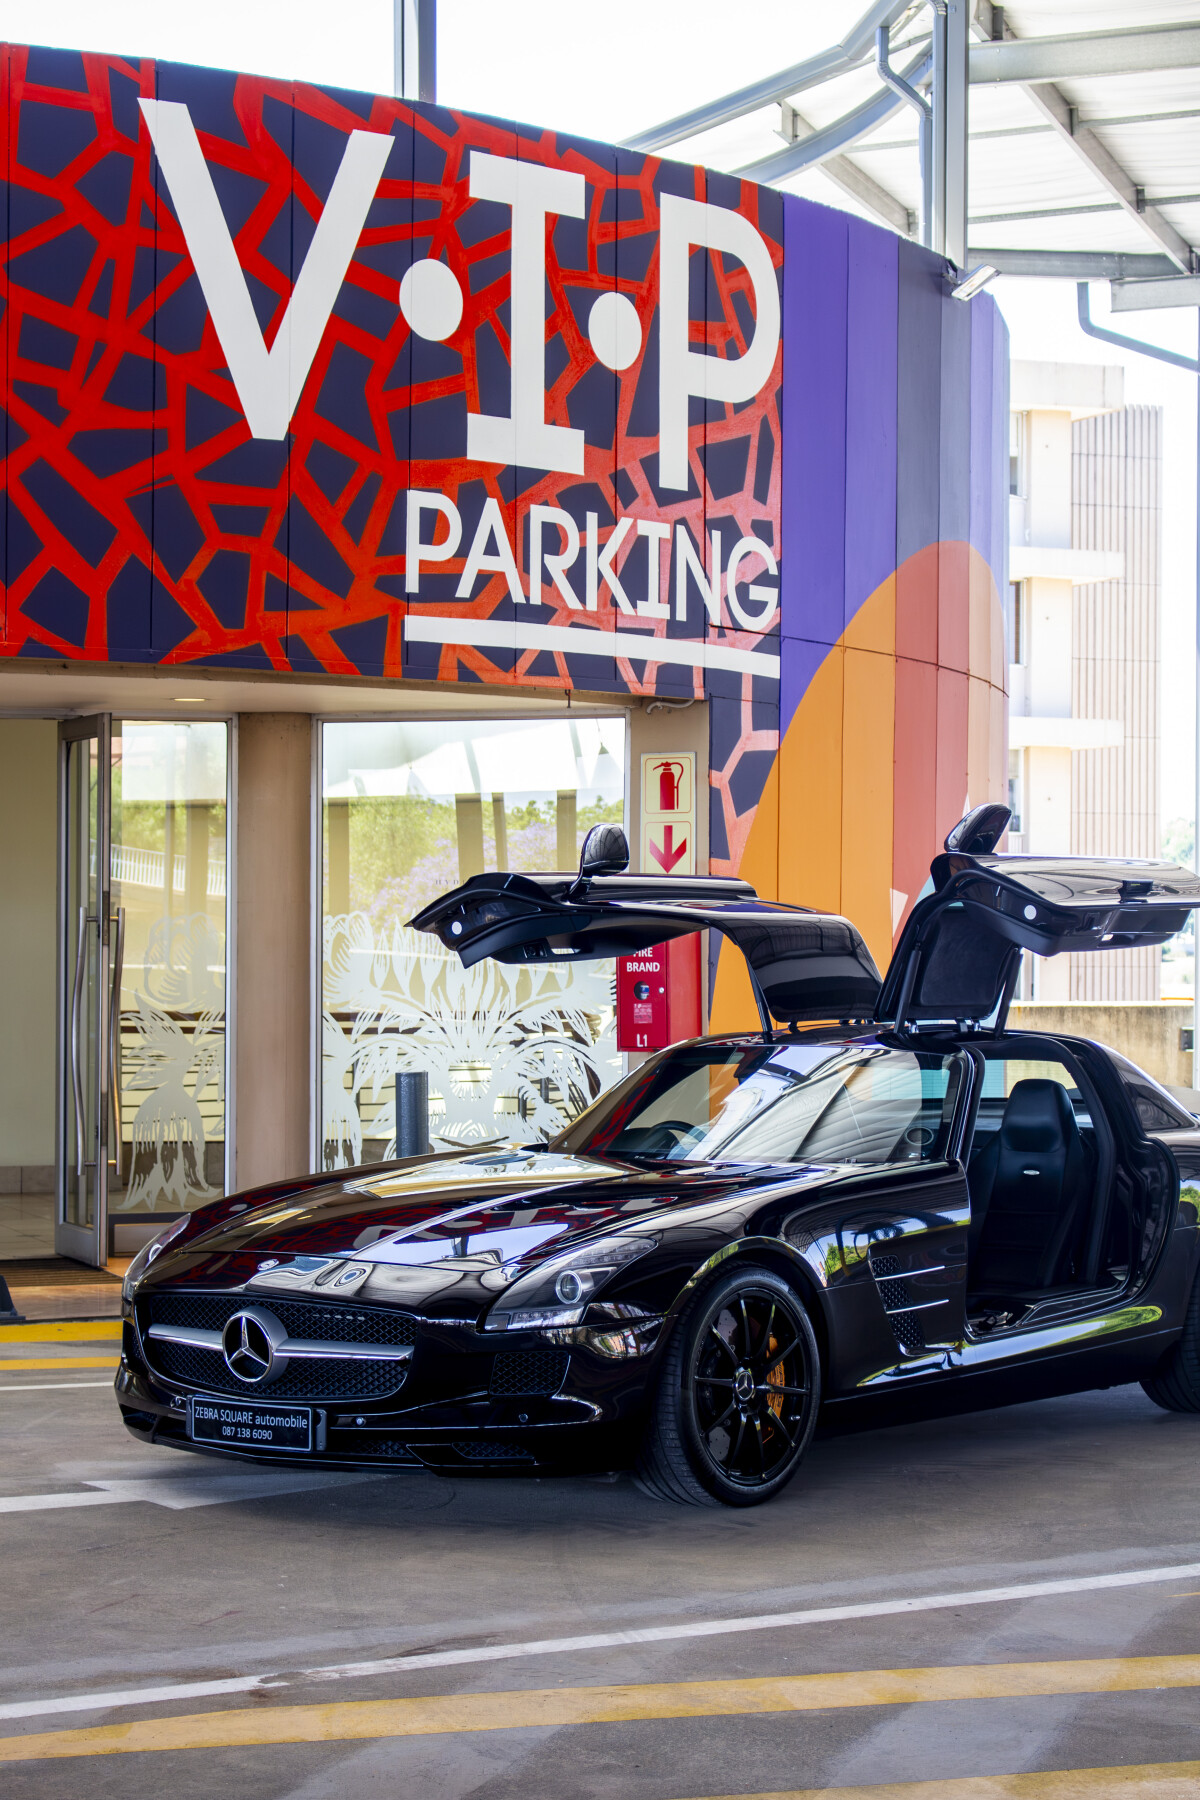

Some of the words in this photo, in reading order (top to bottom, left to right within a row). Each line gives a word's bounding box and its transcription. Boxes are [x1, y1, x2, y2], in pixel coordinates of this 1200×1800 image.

[405, 489, 779, 631] PARKING
[626, 961, 661, 973] BRAND
[636, 1033, 648, 1047] L1
[195, 1406, 219, 1420] ZEBRA
[220, 1409, 253, 1424] SQUARE
[255, 1414, 308, 1428] automobile
[222, 1426, 235, 1436] 087
[237, 1427, 250, 1438] 138
[252, 1429, 273, 1440] 6090
